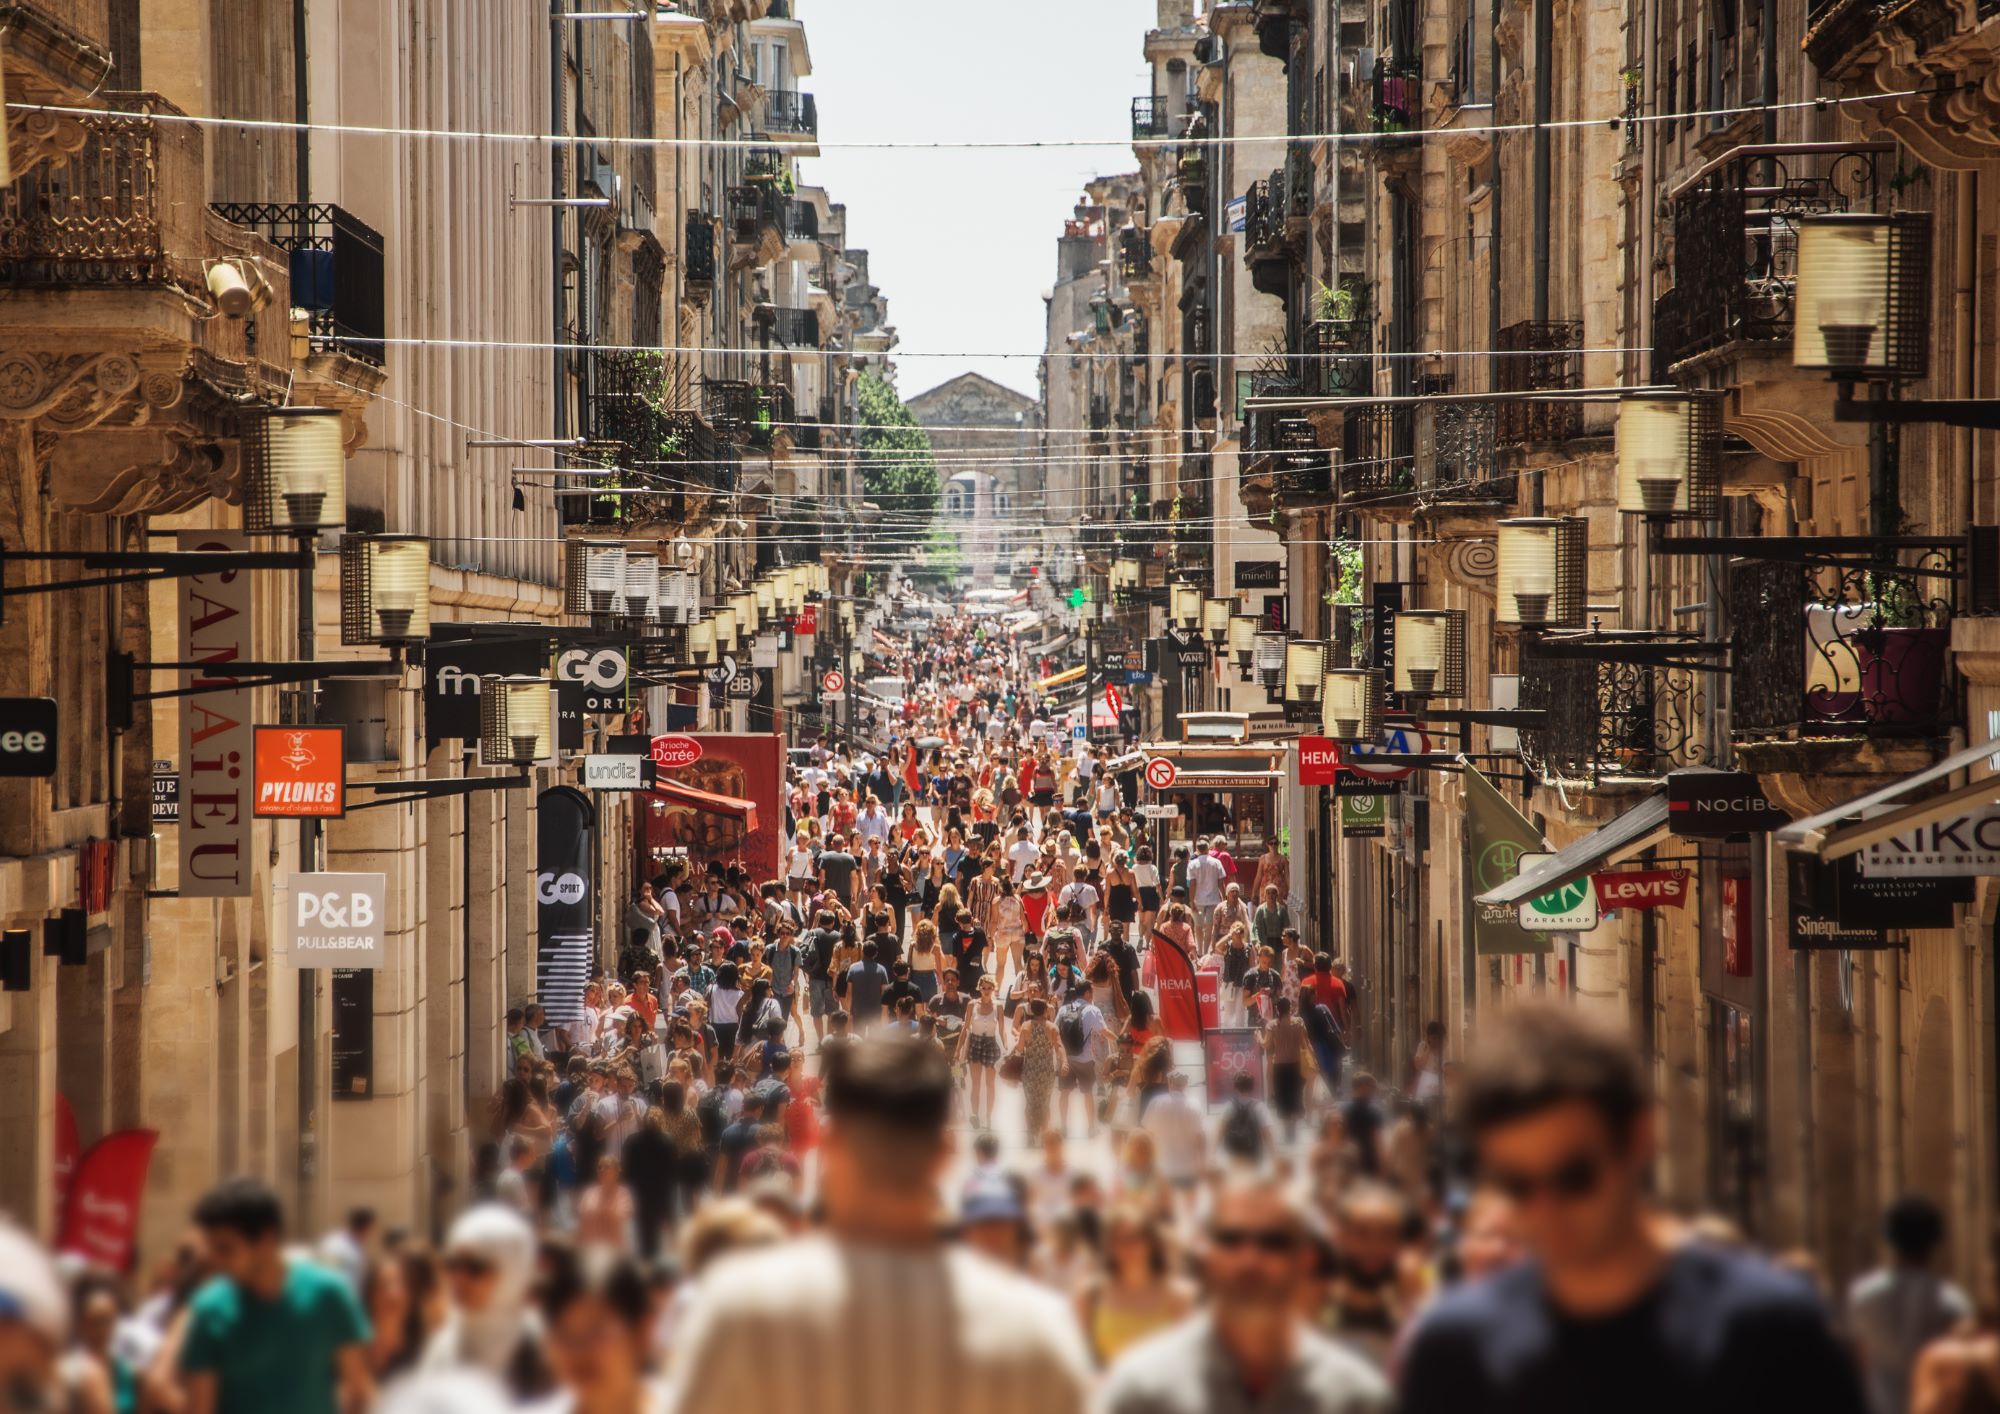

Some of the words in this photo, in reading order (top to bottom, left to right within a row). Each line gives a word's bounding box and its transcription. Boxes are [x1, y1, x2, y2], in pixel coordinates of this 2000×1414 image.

[1384, 605, 1394, 667] FAIRLY
[1178, 652, 1205, 663] VANS
[557, 649, 627, 689] GO
[557, 711, 577, 720] RA
[660, 741, 690, 750] Brioche
[653, 748, 695, 762] Dorée
[588, 762, 637, 780] undiz
[260, 782, 336, 802] PYLONES
[560, 883, 581, 894] SPORT
[297, 892, 374, 928] P&B
[297, 936, 375, 950] PULL&BEAR
[1160, 979, 1193, 990] HEMA
